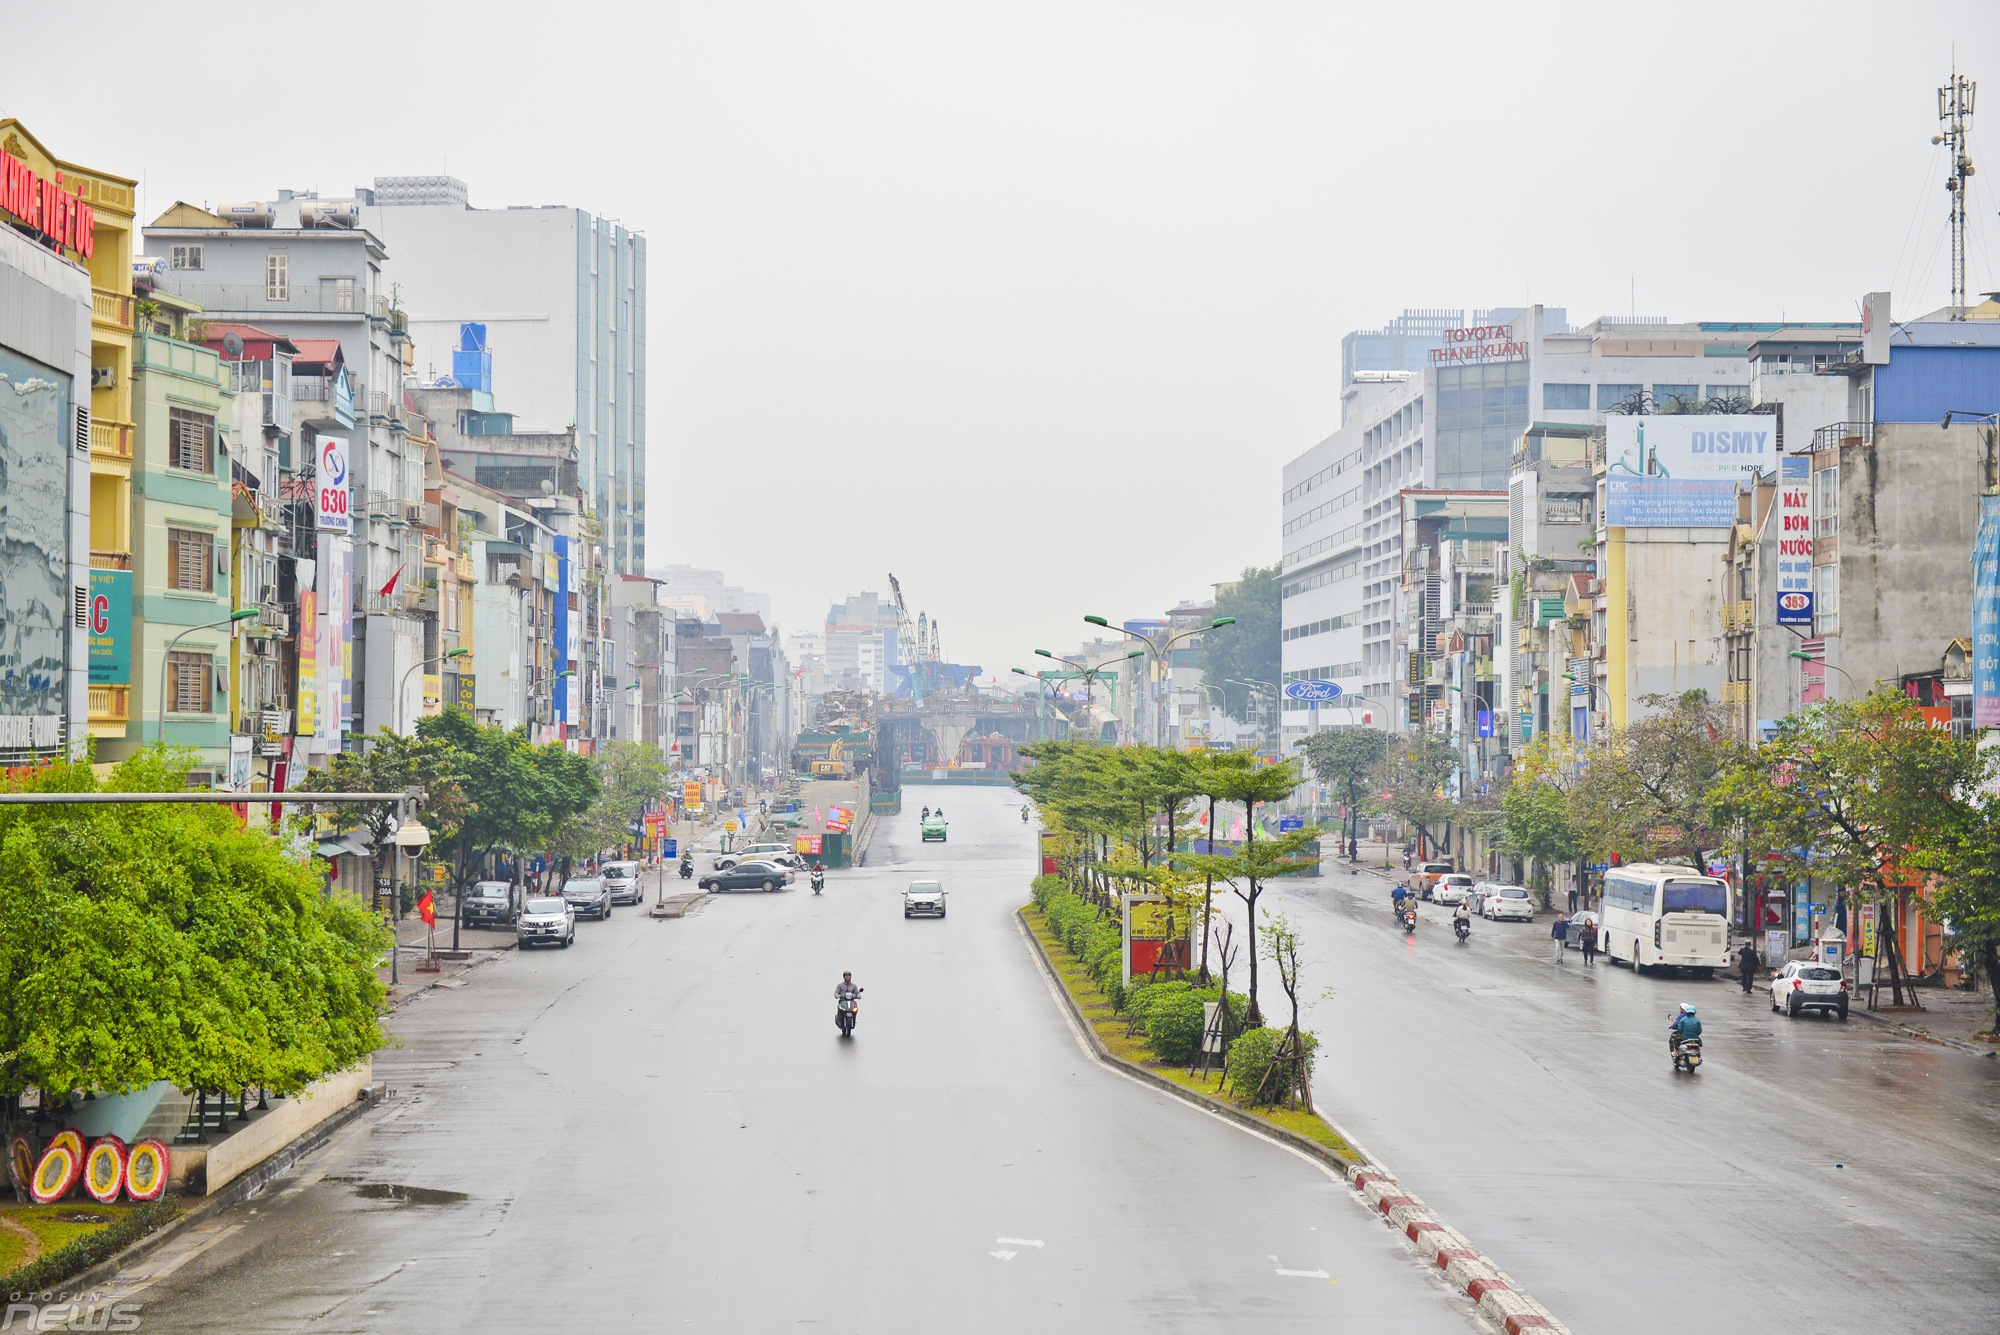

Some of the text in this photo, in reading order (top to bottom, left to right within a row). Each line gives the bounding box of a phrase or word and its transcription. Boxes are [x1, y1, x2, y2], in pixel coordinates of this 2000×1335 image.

[40, 171, 74, 255] VIỆT
[74, 185, 95, 259] ỨC
[1445, 325, 1506, 342] TOYOTA
[1430, 339, 1523, 362] THANH XUÂN
[1692, 431, 1767, 453] DISMY
[1718, 464, 1738, 472] PP-R
[1741, 464, 1764, 472] HDPE
[1630, 482, 1655, 492] CÔNG
[1658, 484, 1669, 492] TY
[321, 488, 346, 514] 630
[1783, 487, 1808, 507] MÁY
[320, 515, 347, 527] TRƯỜNG CHINH
[1784, 514, 1809, 531] BƠM
[1982, 523, 1998, 538] VẬT
[1780, 535, 1812, 555] NƯỚC
[1984, 543, 1996, 553] TƯ
[1981, 560, 1998, 576] PHỤ
[98, 575, 115, 584] VIỆT
[1785, 595, 1805, 609] 363
[1980, 656, 1999, 672] BỘT
[1296, 684, 1331, 698] Ford
[1983, 677, 1996, 691] BẢ
[1982, 698, 1998, 706] 371
[820, 764, 831, 772] CAT
